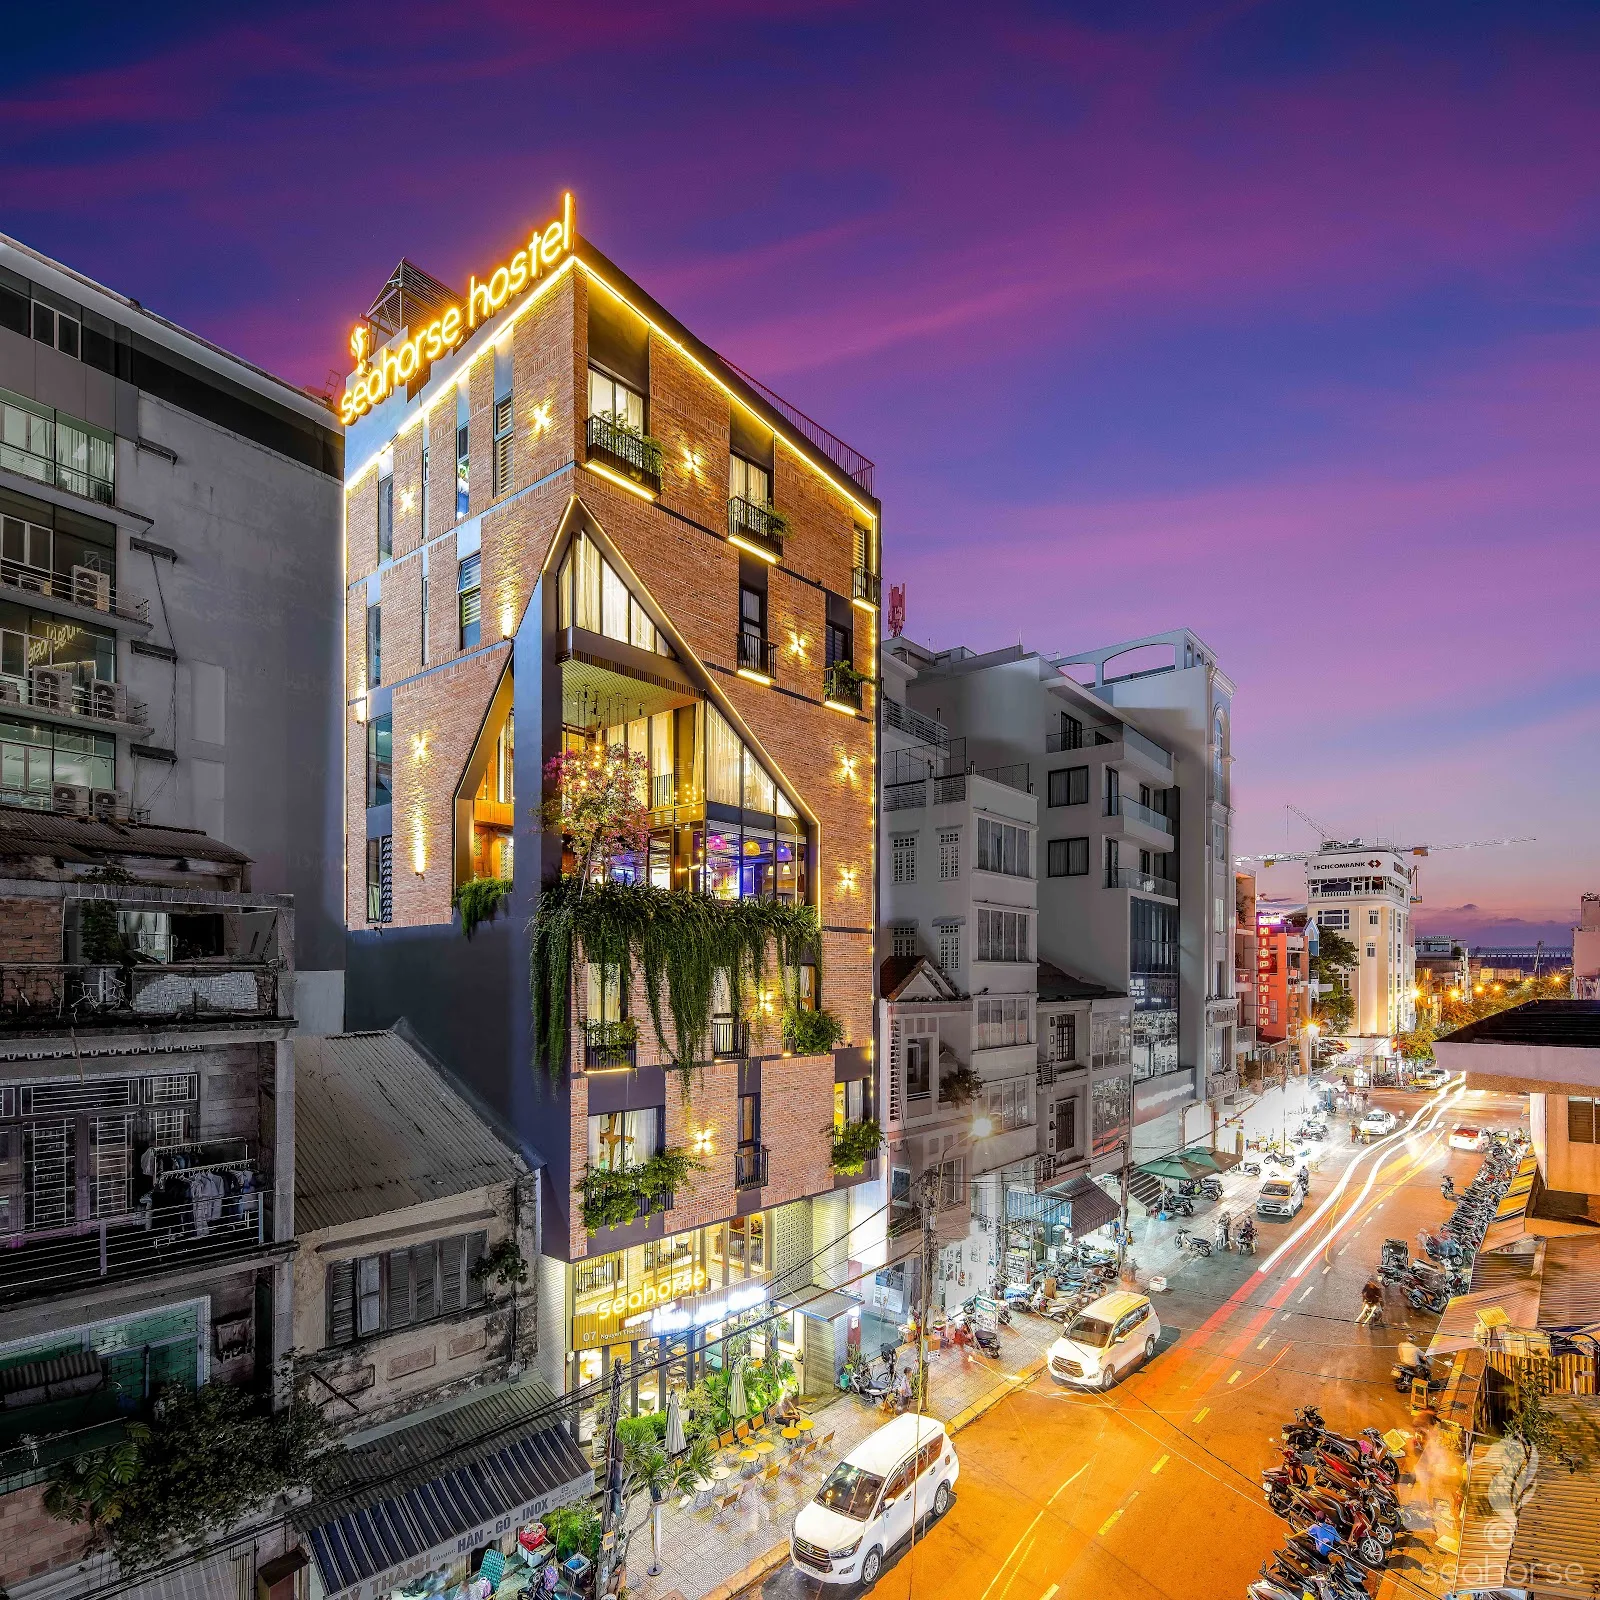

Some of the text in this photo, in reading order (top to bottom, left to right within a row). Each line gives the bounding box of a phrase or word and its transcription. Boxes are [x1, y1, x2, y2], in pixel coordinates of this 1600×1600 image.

[341, 192, 573, 425] seahorse hostel
[1313, 861, 1365, 870] TECHCOMBANK
[597, 1269, 705, 1320] seahorse
[583, 1331, 596, 1342] 07
[522, 1497, 549, 1521] INOX
